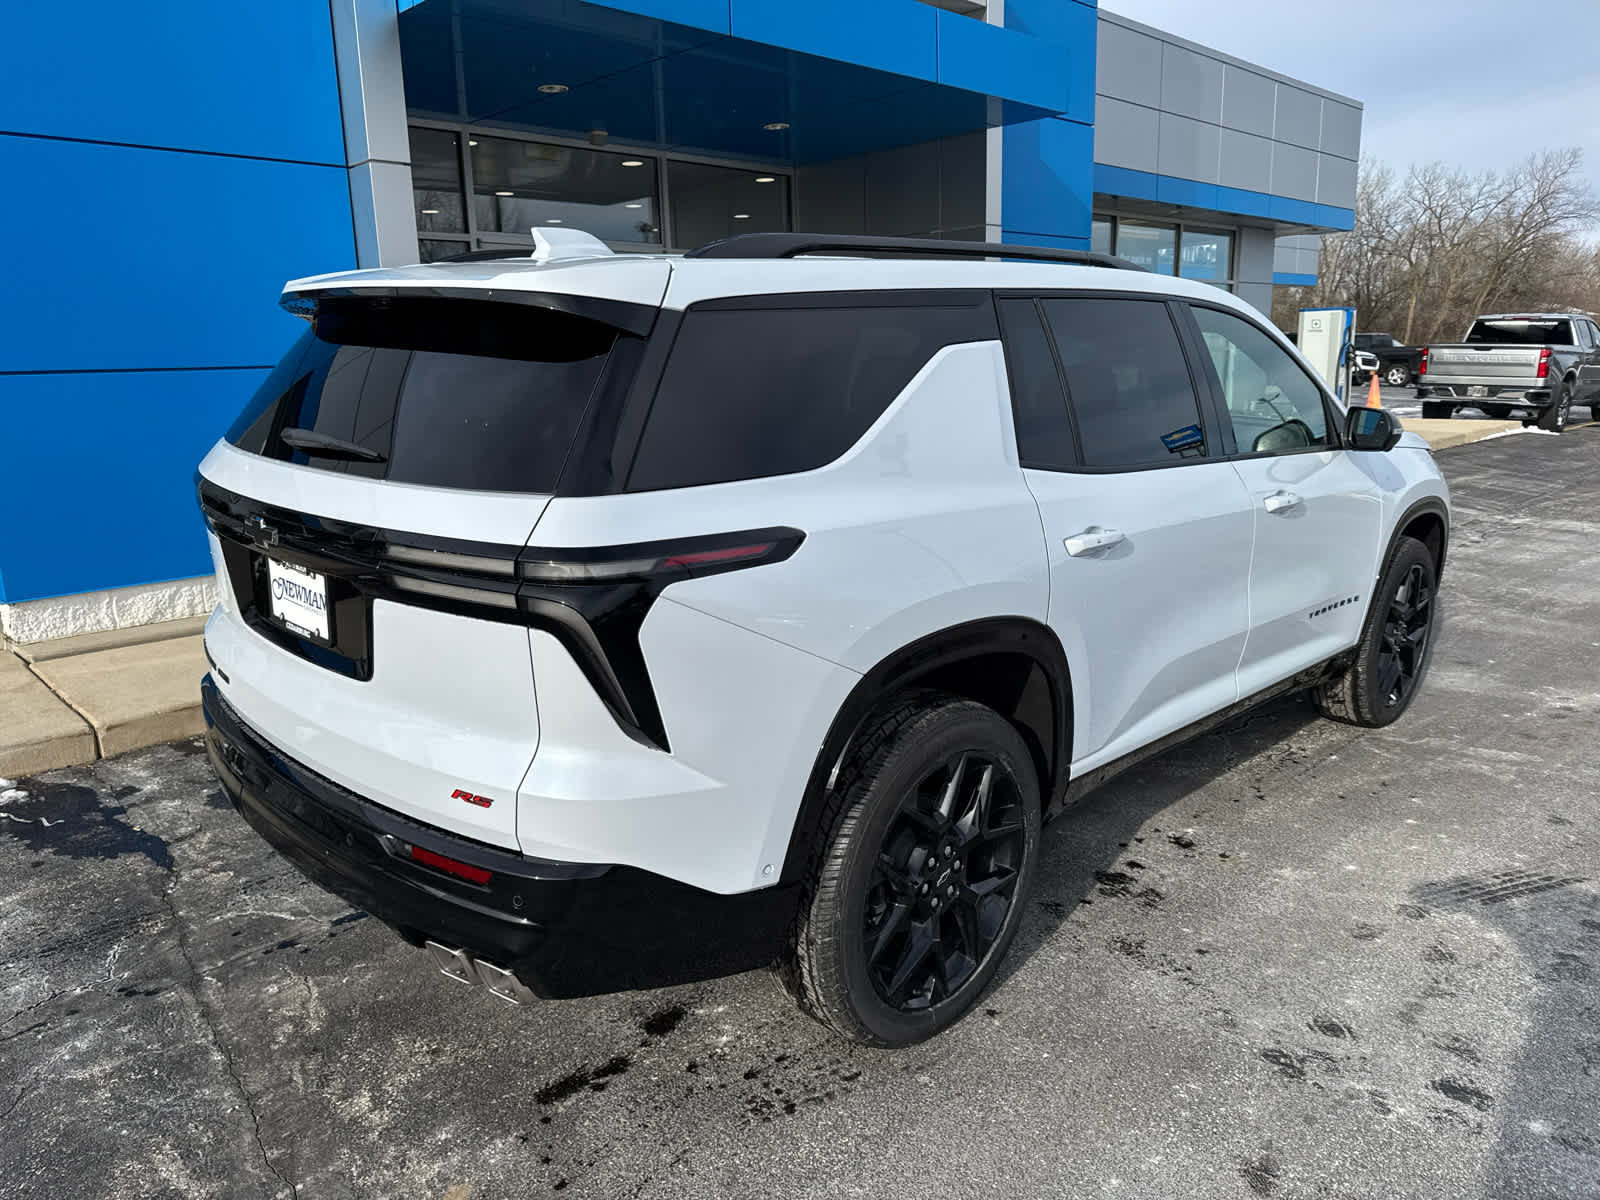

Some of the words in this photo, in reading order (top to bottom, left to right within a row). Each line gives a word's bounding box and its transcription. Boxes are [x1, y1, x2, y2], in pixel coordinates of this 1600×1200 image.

[272, 577, 326, 611] NEWMAN
[1309, 595, 1359, 619] TRAVERSE
[451, 789, 494, 808] RS
